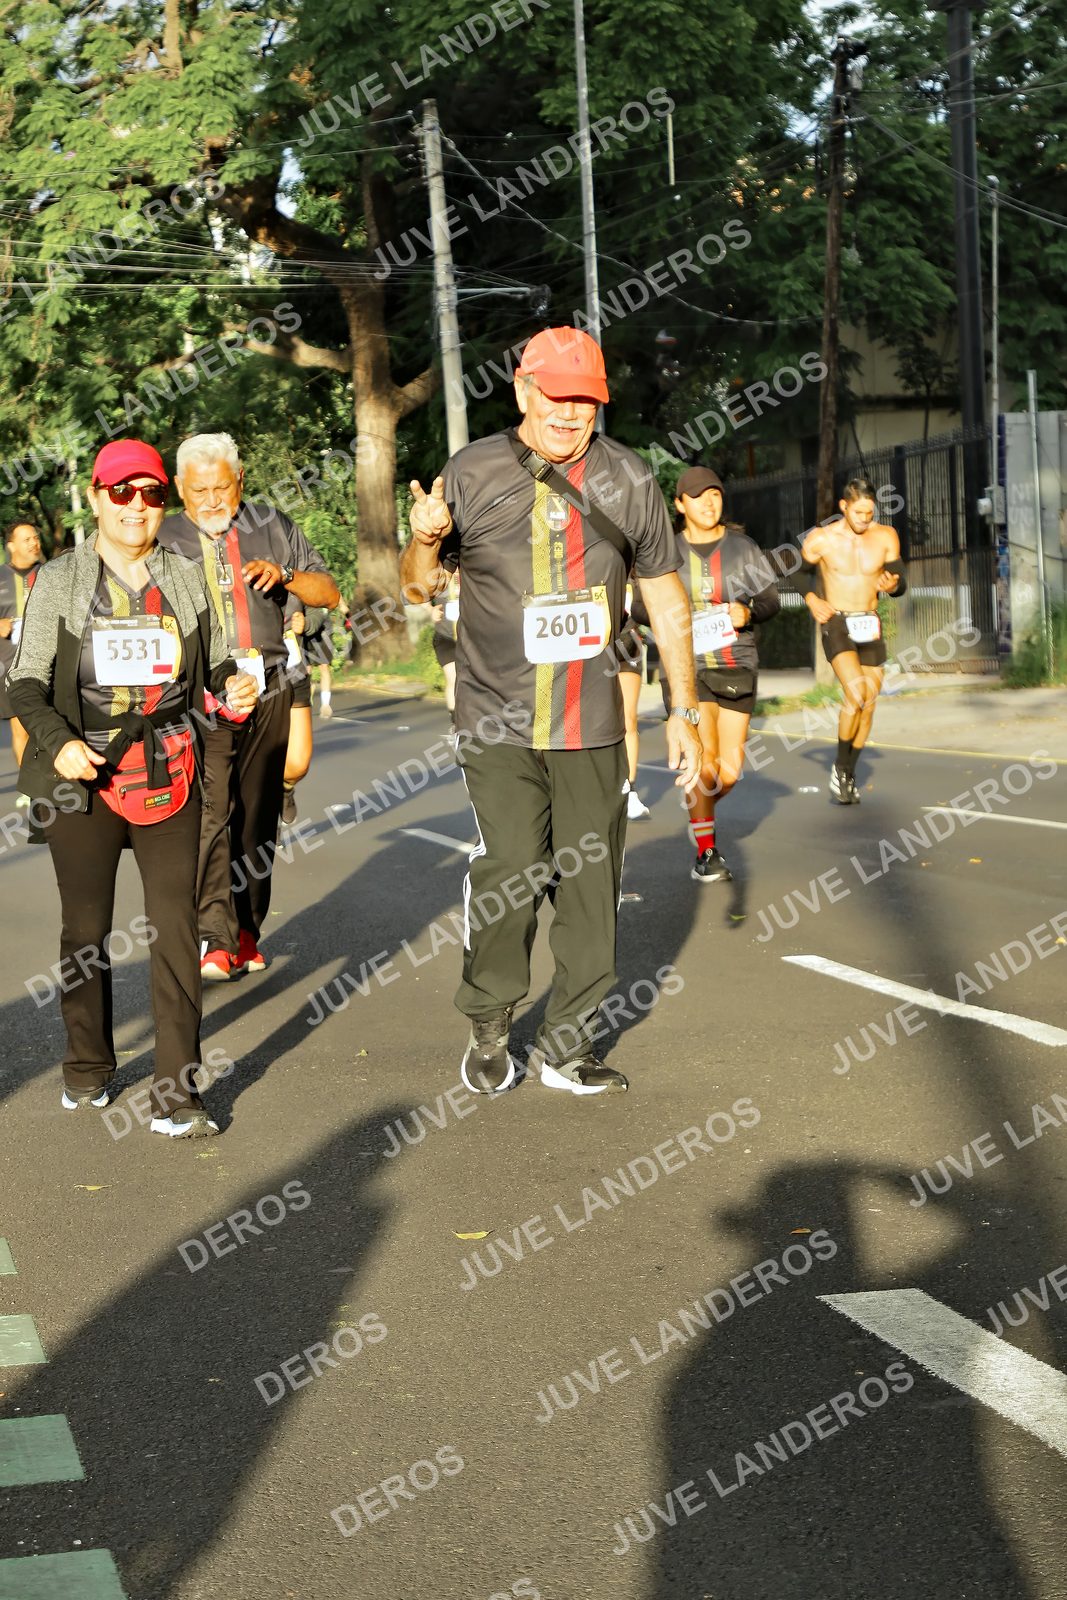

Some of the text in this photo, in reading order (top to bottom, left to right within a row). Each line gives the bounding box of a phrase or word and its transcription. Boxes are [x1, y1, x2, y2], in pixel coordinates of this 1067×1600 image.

[594, 592, 604, 600] 5K
[535, 612, 590, 638] 2601
[107, 638, 161, 660] 5531
